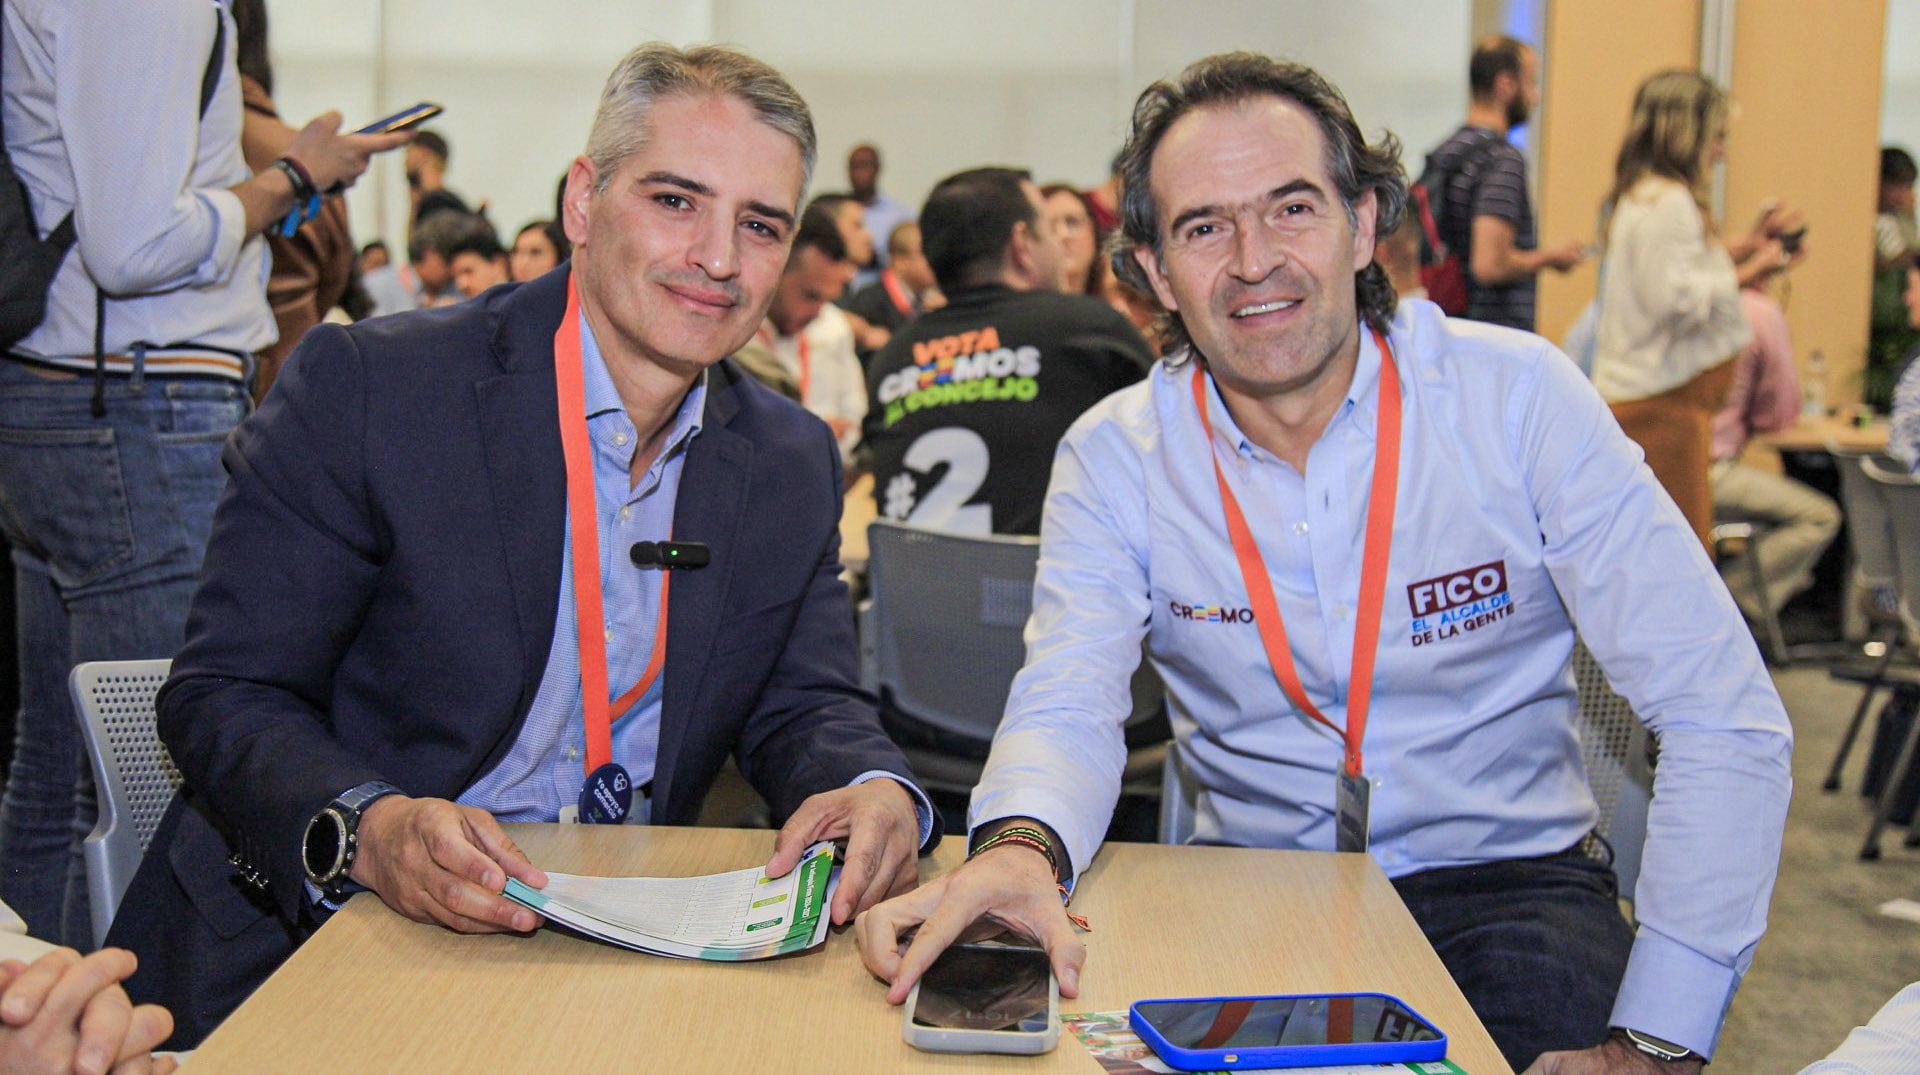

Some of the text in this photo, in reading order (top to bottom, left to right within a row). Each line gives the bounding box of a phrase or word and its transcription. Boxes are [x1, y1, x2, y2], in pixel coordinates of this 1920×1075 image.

[912, 325, 1000, 365] VOTA
[877, 345, 1041, 404] CREEMOS
[904, 376, 1039, 412] CONCEJO
[884, 426, 993, 533] #2
[1170, 601, 1254, 624] CREEMO
[1412, 567, 1501, 615] FICO
[1412, 591, 1511, 633] EL ALCALDE
[1411, 602, 1515, 647] DE LA GENTE
